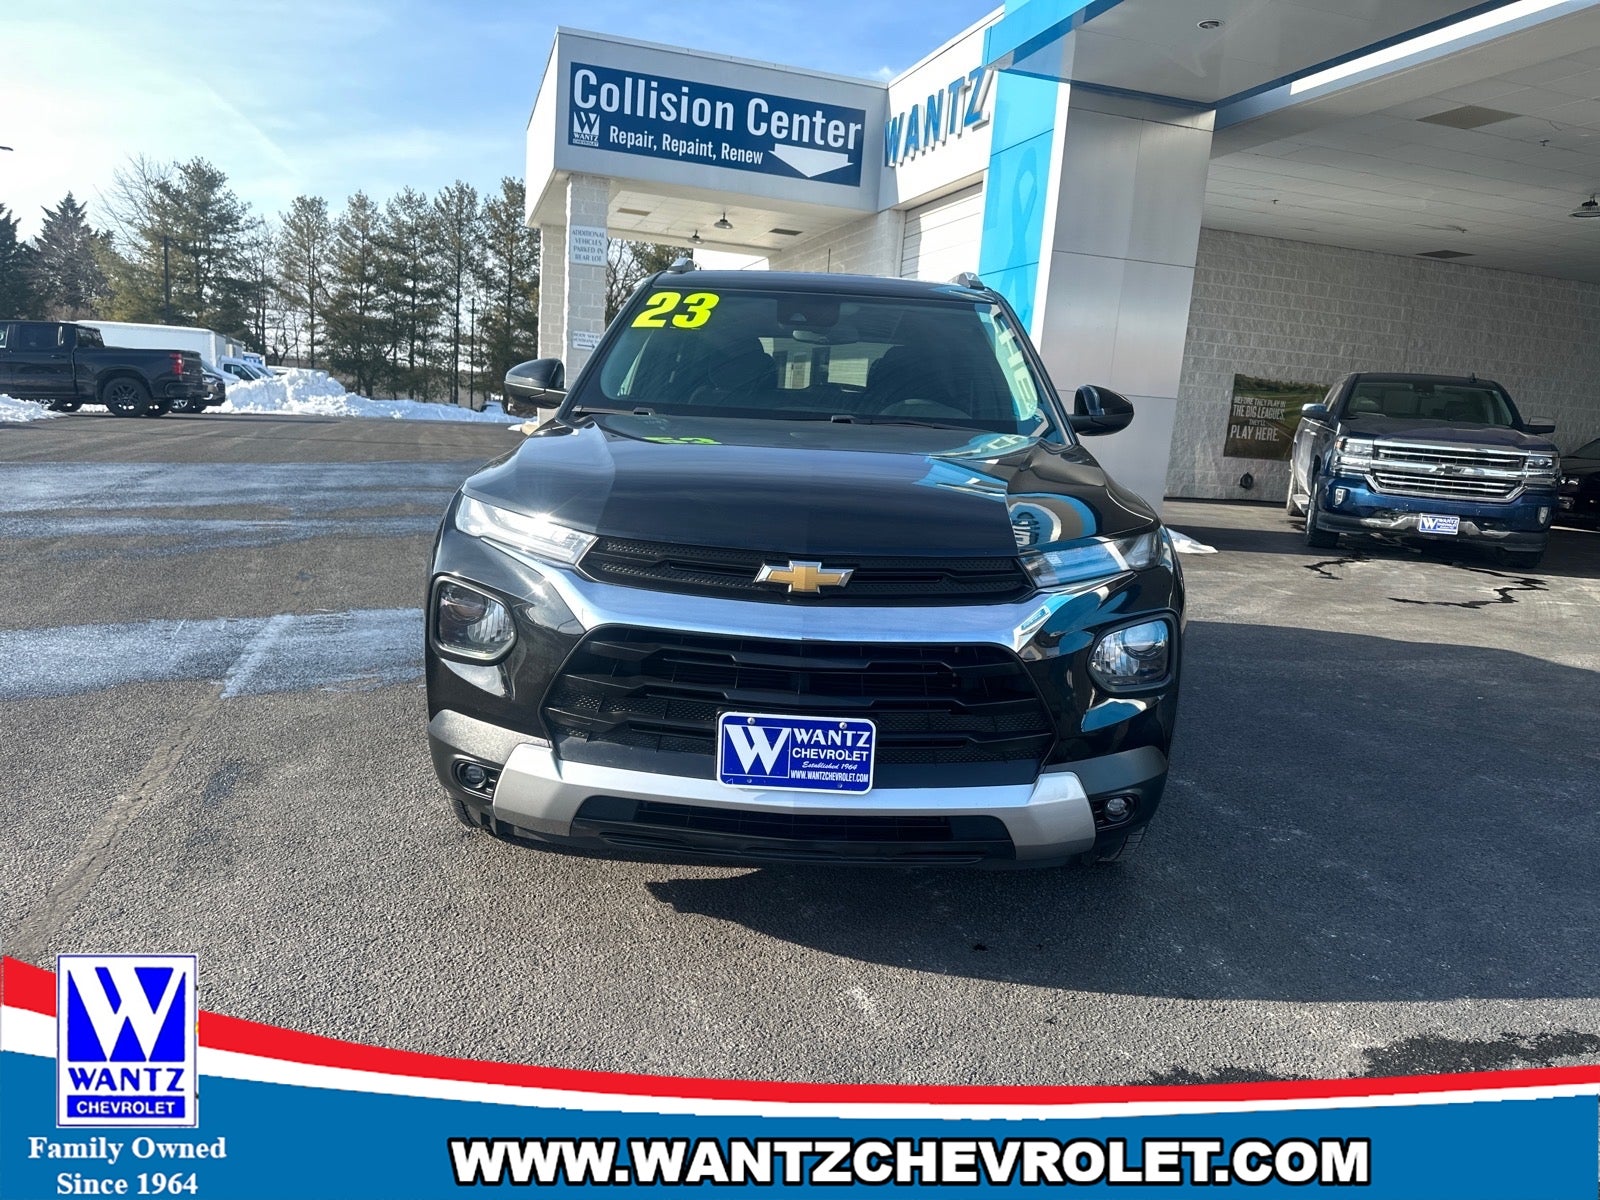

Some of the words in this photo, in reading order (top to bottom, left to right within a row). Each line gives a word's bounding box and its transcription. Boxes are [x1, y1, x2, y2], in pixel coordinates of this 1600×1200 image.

[573, 69, 734, 131] Collision
[747, 97, 862, 150] Center
[885, 66, 988, 167] WANTZ
[573, 132, 599, 142] WANTZ
[609, 125, 657, 151] Repair,
[662, 133, 717, 161] Repaint,
[721, 142, 763, 165] Renew
[631, 291, 720, 328] 23
[1233, 405, 1245, 417] THE
[1245, 405, 1257, 418] BIG
[1230, 425, 1254, 440] PLAY
[1255, 427, 1280, 442] HERE.
[792, 728, 871, 748] WANTZ
[725, 725, 791, 776] W
[792, 747, 869, 761] CHEVROLET
[802, 761, 840, 770] Established
[840, 763, 858, 771] 1964
[790, 769, 869, 783] WWW.WANTZCHEVROLET.COM
